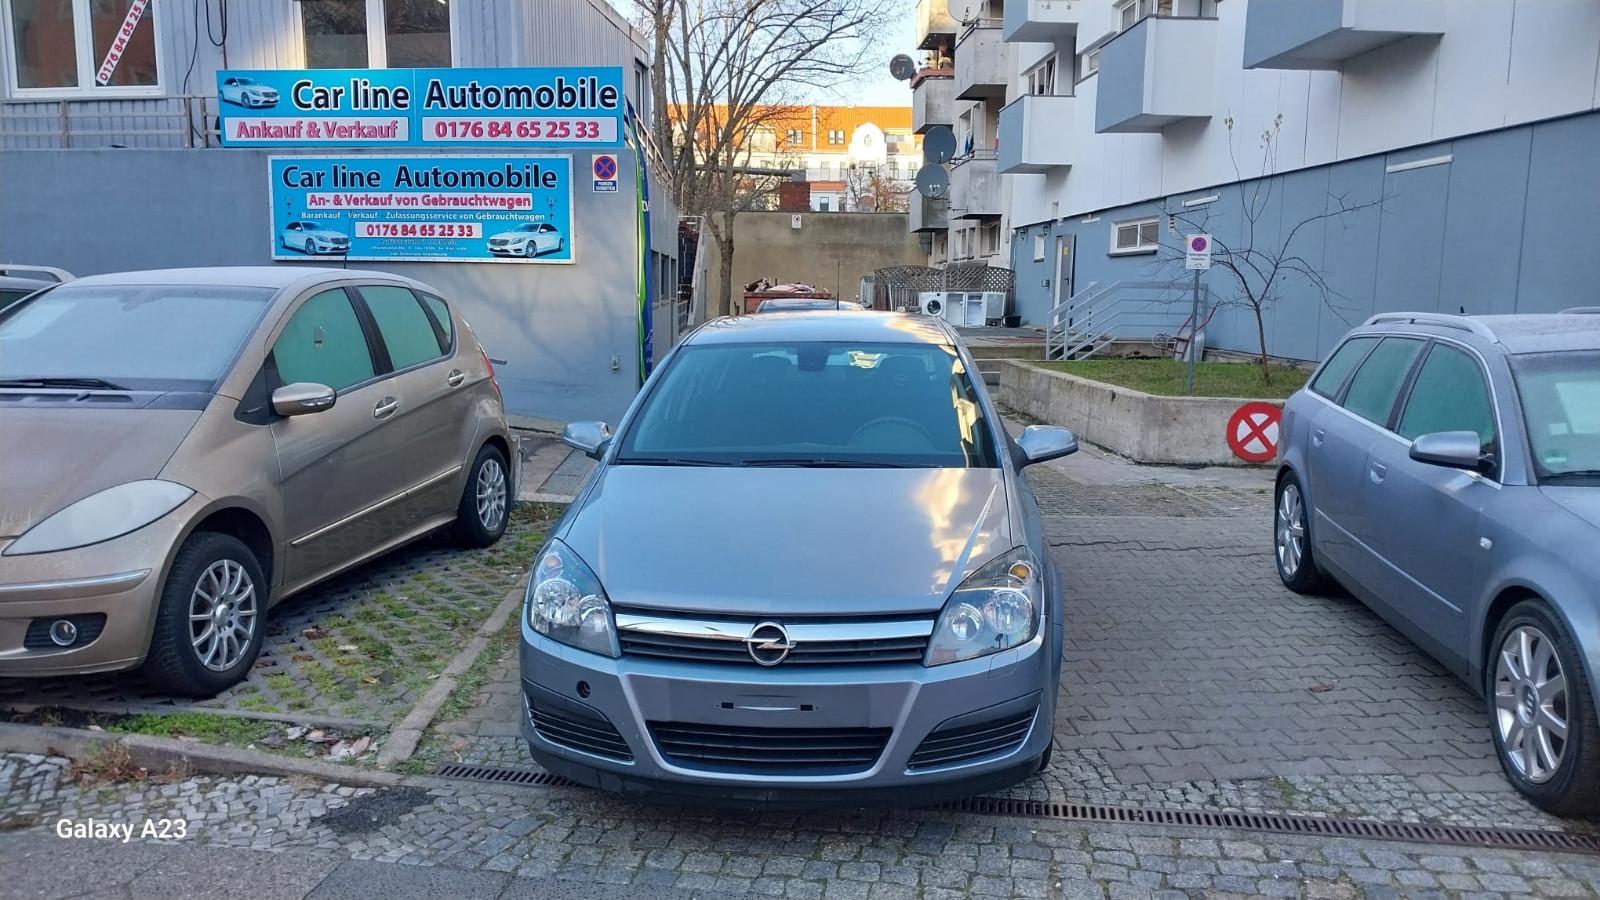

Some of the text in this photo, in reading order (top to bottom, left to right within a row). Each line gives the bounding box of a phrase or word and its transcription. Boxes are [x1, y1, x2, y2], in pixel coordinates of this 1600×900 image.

[100, 53, 119, 81] 0176
[114, 37, 126, 52] 84
[122, 21, 134, 36] 65
[129, 5, 142, 20] 25
[292, 76, 618, 110] Car line Automobile
[237, 121, 398, 139] Ankauf & Verkauf
[435, 121, 600, 138] 0176 84 65 25 33
[282, 163, 558, 188] Car line Automobile
[309, 193, 531, 209] An- & Verkauf von Gebrauchtwagen
[301, 211, 341, 219] Barankauf
[347, 211, 378, 219] Verkauf
[385, 211, 457, 221] Zulassungsservice
[475, 212, 545, 221] Gebrauchtwagen
[366, 224, 473, 237] 0176 84 65 25 33
